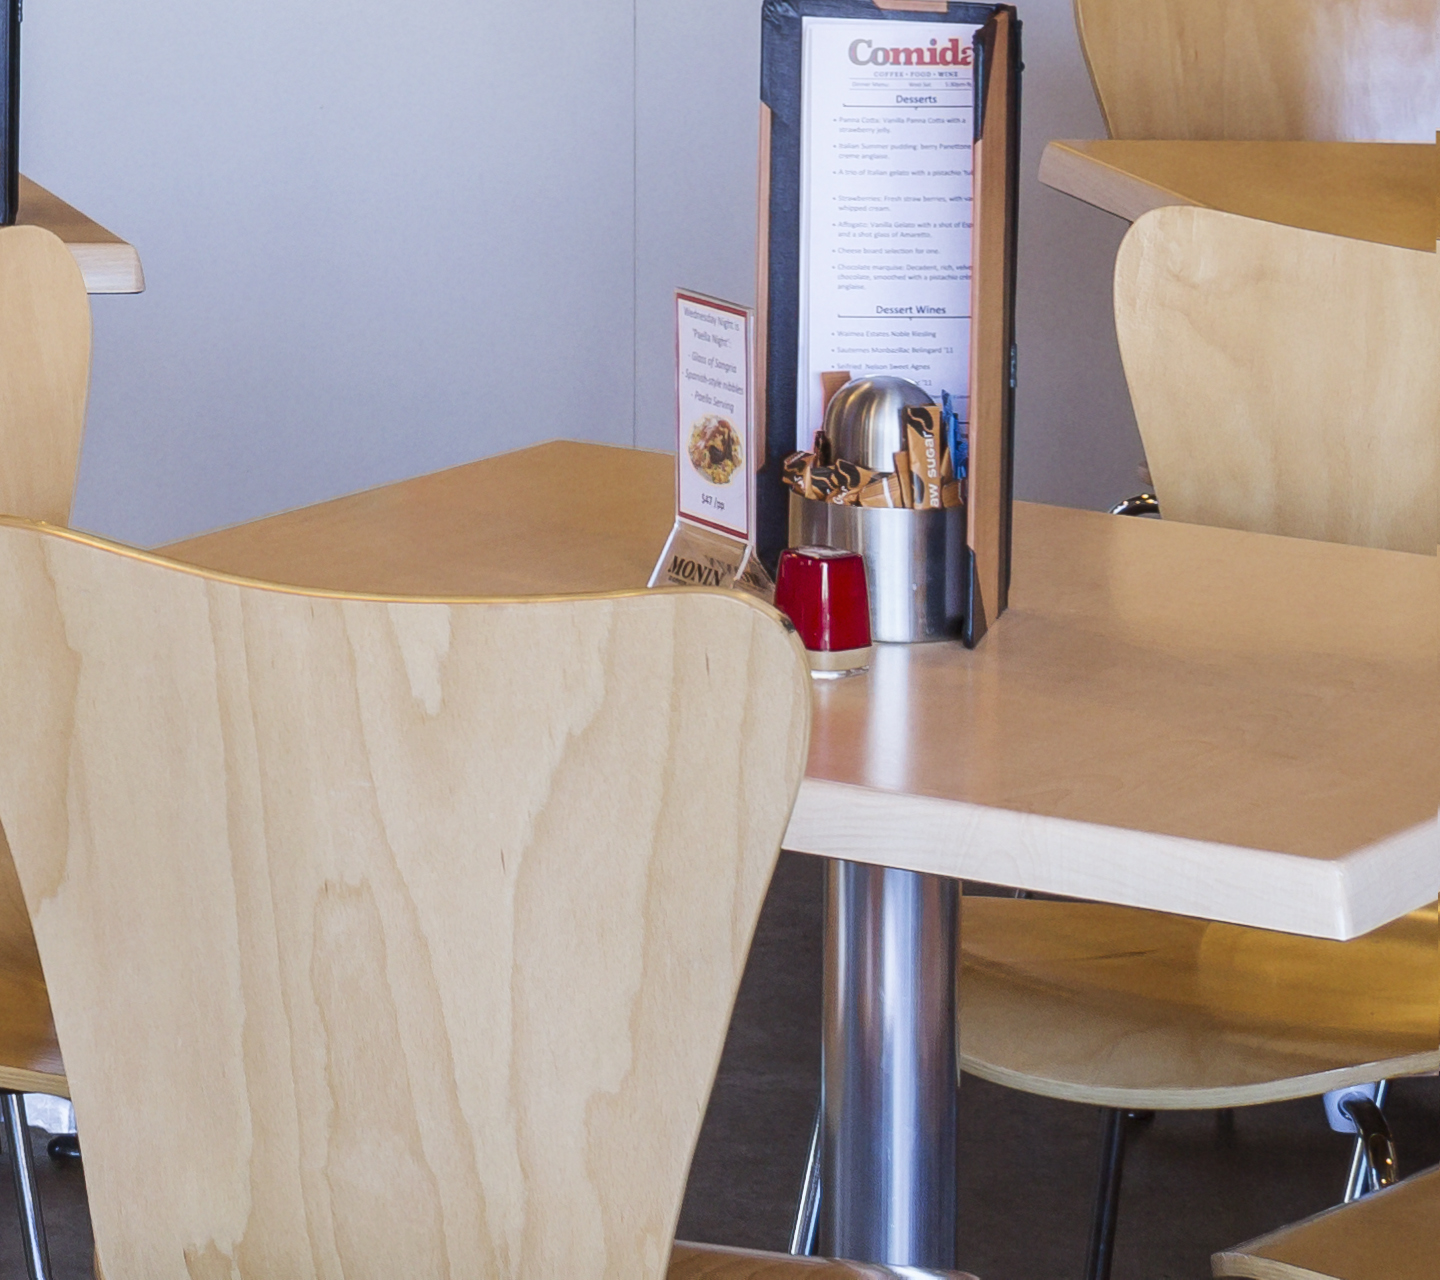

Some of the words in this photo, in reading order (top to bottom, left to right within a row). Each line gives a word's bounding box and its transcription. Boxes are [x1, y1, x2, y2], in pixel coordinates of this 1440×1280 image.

[848, 37, 972, 66] Comida
[896, 95, 938, 104] Desserts
[920, 143, 938, 151] berry
[889, 169, 910, 178] gelato
[932, 169, 961, 177] pistachio
[683, 307, 717, 325] Wednesday
[717, 316, 733, 331] Night
[734, 321, 740, 332] is
[876, 306, 913, 315] Dessert
[916, 306, 947, 315] Wines
[912, 330, 936, 339] Riesling
[707, 354, 715, 369] of
[715, 360, 737, 375] Sangria
[694, 391, 713, 406] Paella
[713, 396, 734, 414] Serving
[923, 430, 938, 479] sugar
[701, 492, 713, 506] $47
[929, 483, 939, 509] aw
[667, 555, 724, 588] MONIN
